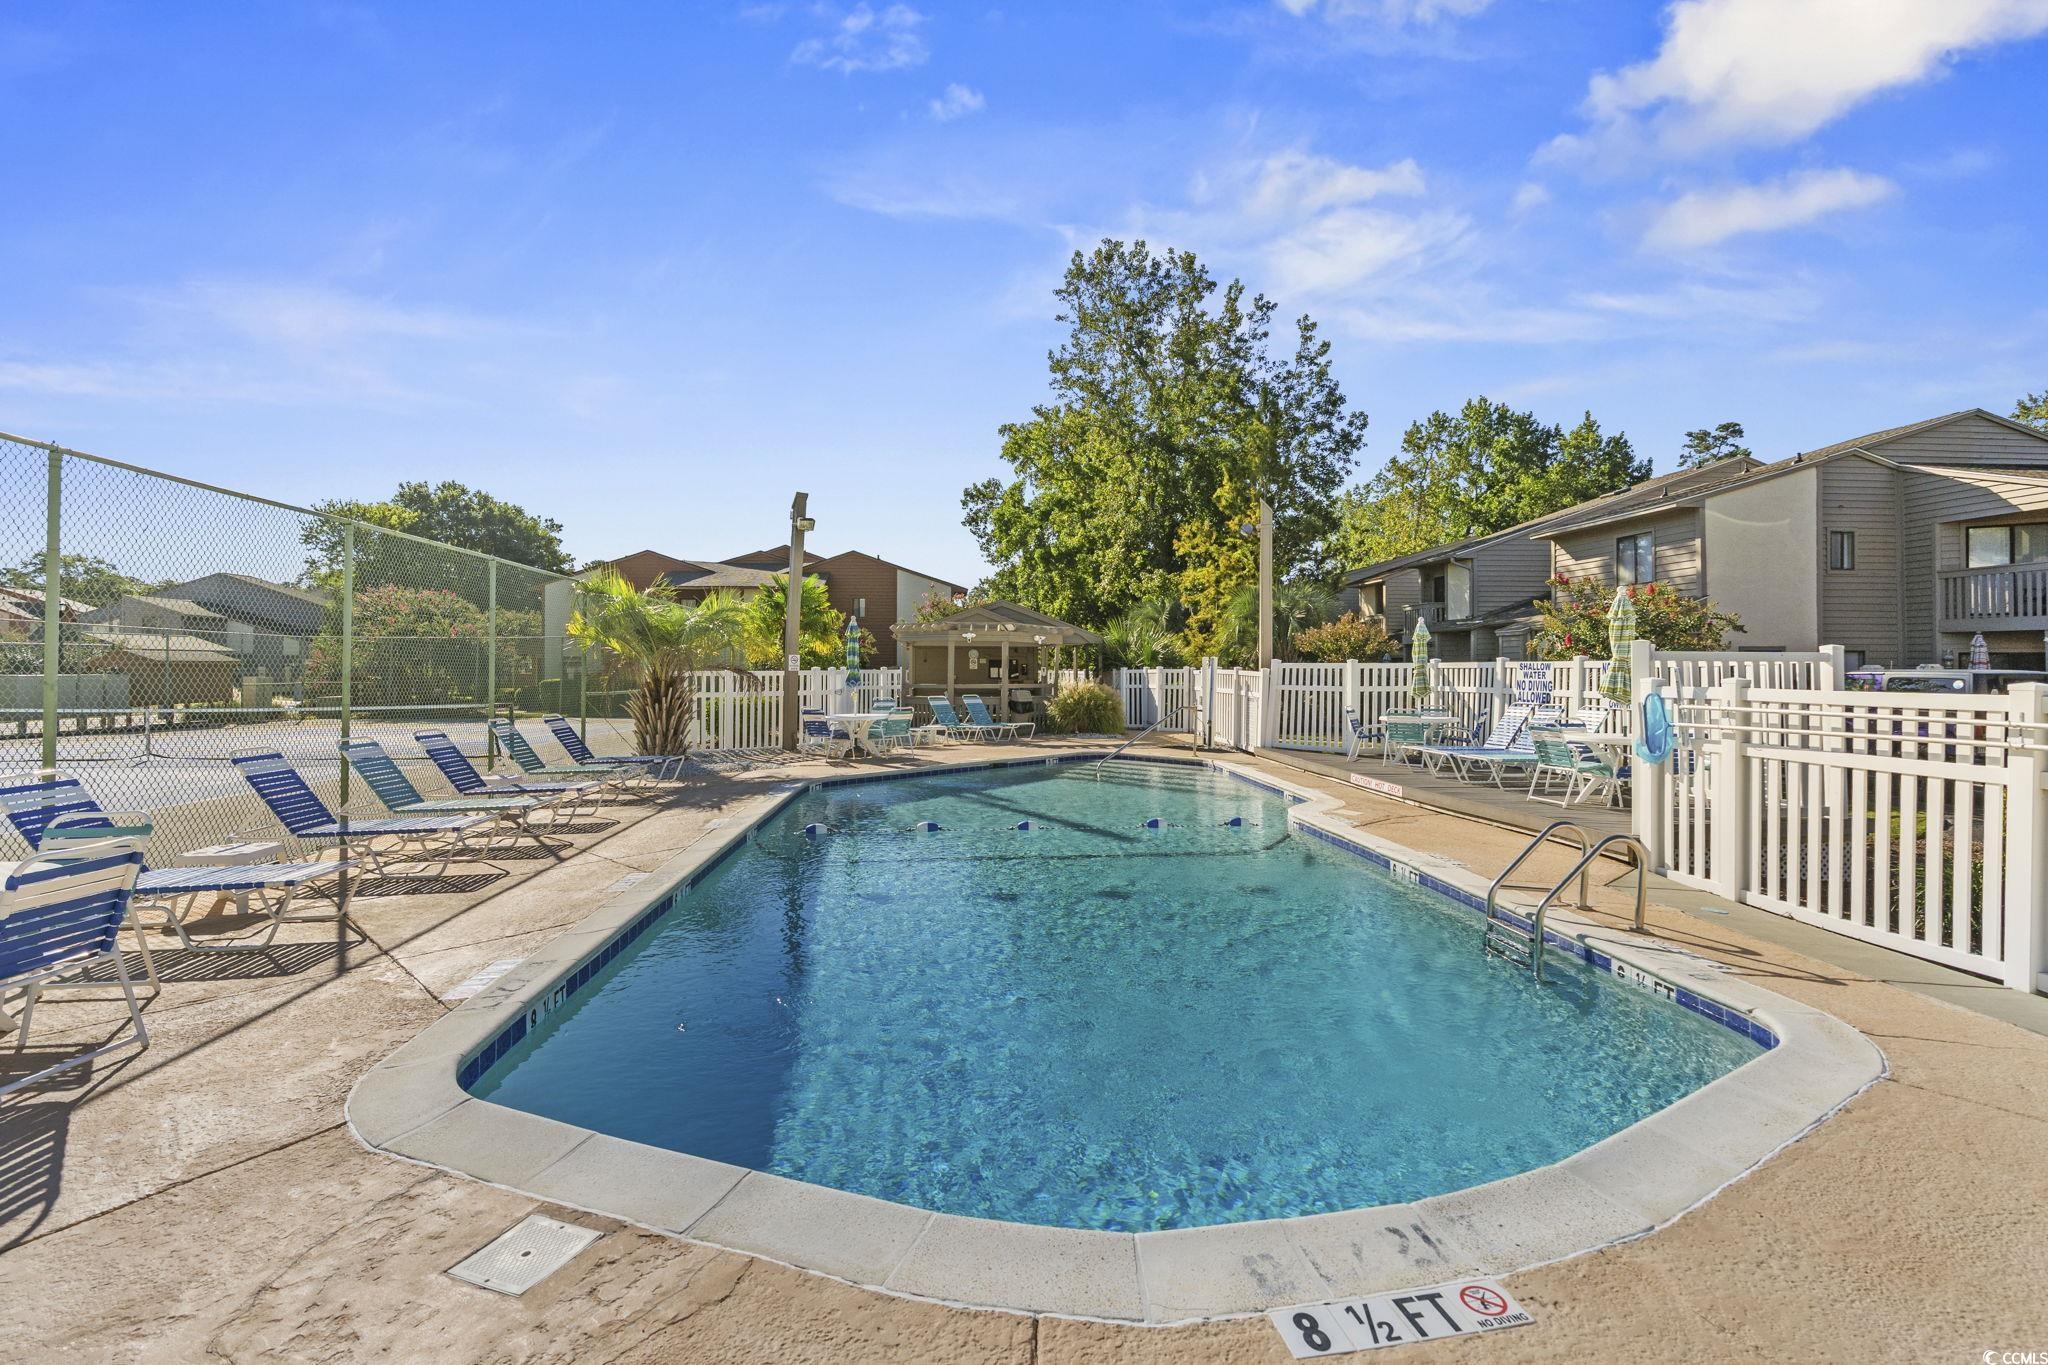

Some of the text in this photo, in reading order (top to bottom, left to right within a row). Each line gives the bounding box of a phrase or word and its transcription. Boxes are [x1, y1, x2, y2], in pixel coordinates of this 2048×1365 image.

[1519, 663, 1551, 671] SHALLOW
[1523, 671, 1546, 680] WATER
[1516, 680, 1553, 692] NO DIVING
[1517, 691, 1551, 703] ALLOWED
[1374, 782, 1385, 790] HOT
[1388, 785, 1401, 794] DECK
[1653, 980, 1675, 999] FT
[554, 984, 565, 1008] FT
[1292, 1312, 1332, 1352] 8
[1391, 1292, 1464, 1338] FT
[1477, 1312, 1530, 1329] NO DIVING
